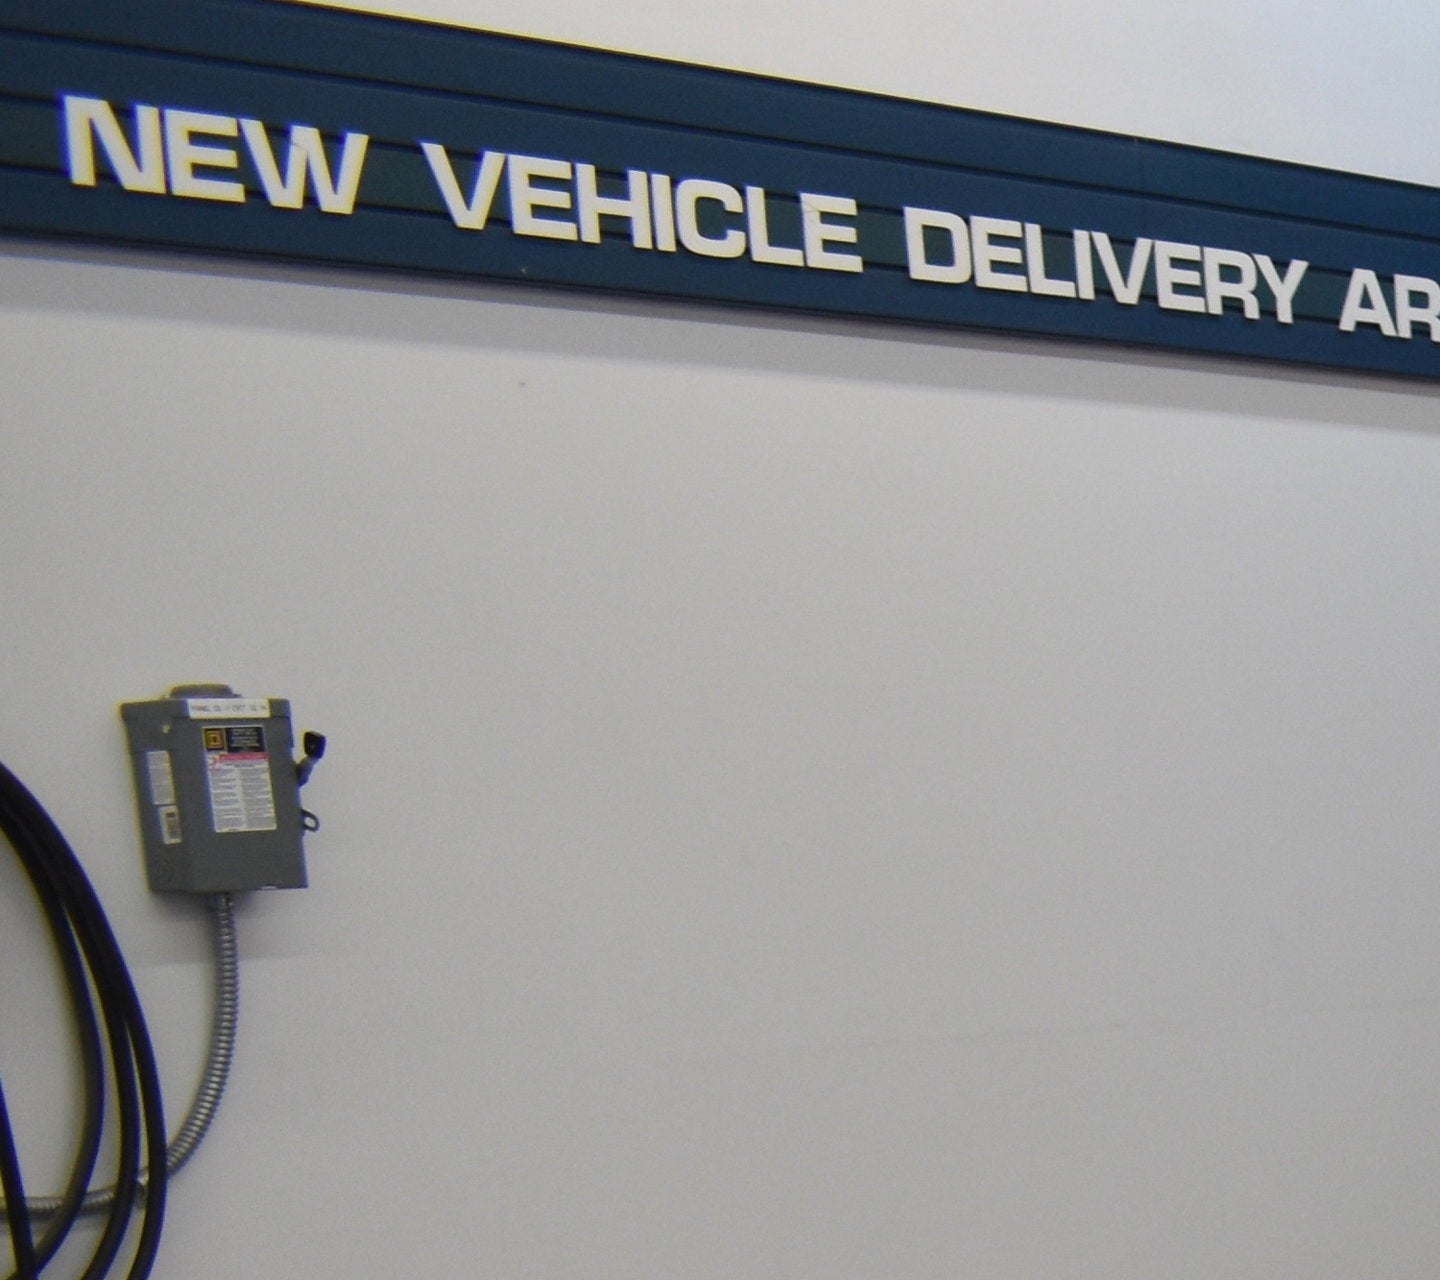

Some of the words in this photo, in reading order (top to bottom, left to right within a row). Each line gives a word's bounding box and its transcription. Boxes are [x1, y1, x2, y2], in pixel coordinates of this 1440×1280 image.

[63, 95, 369, 215] NEW
[421, 141, 864, 274] VEHICLE
[902, 205, 1309, 325] DELIVERY
